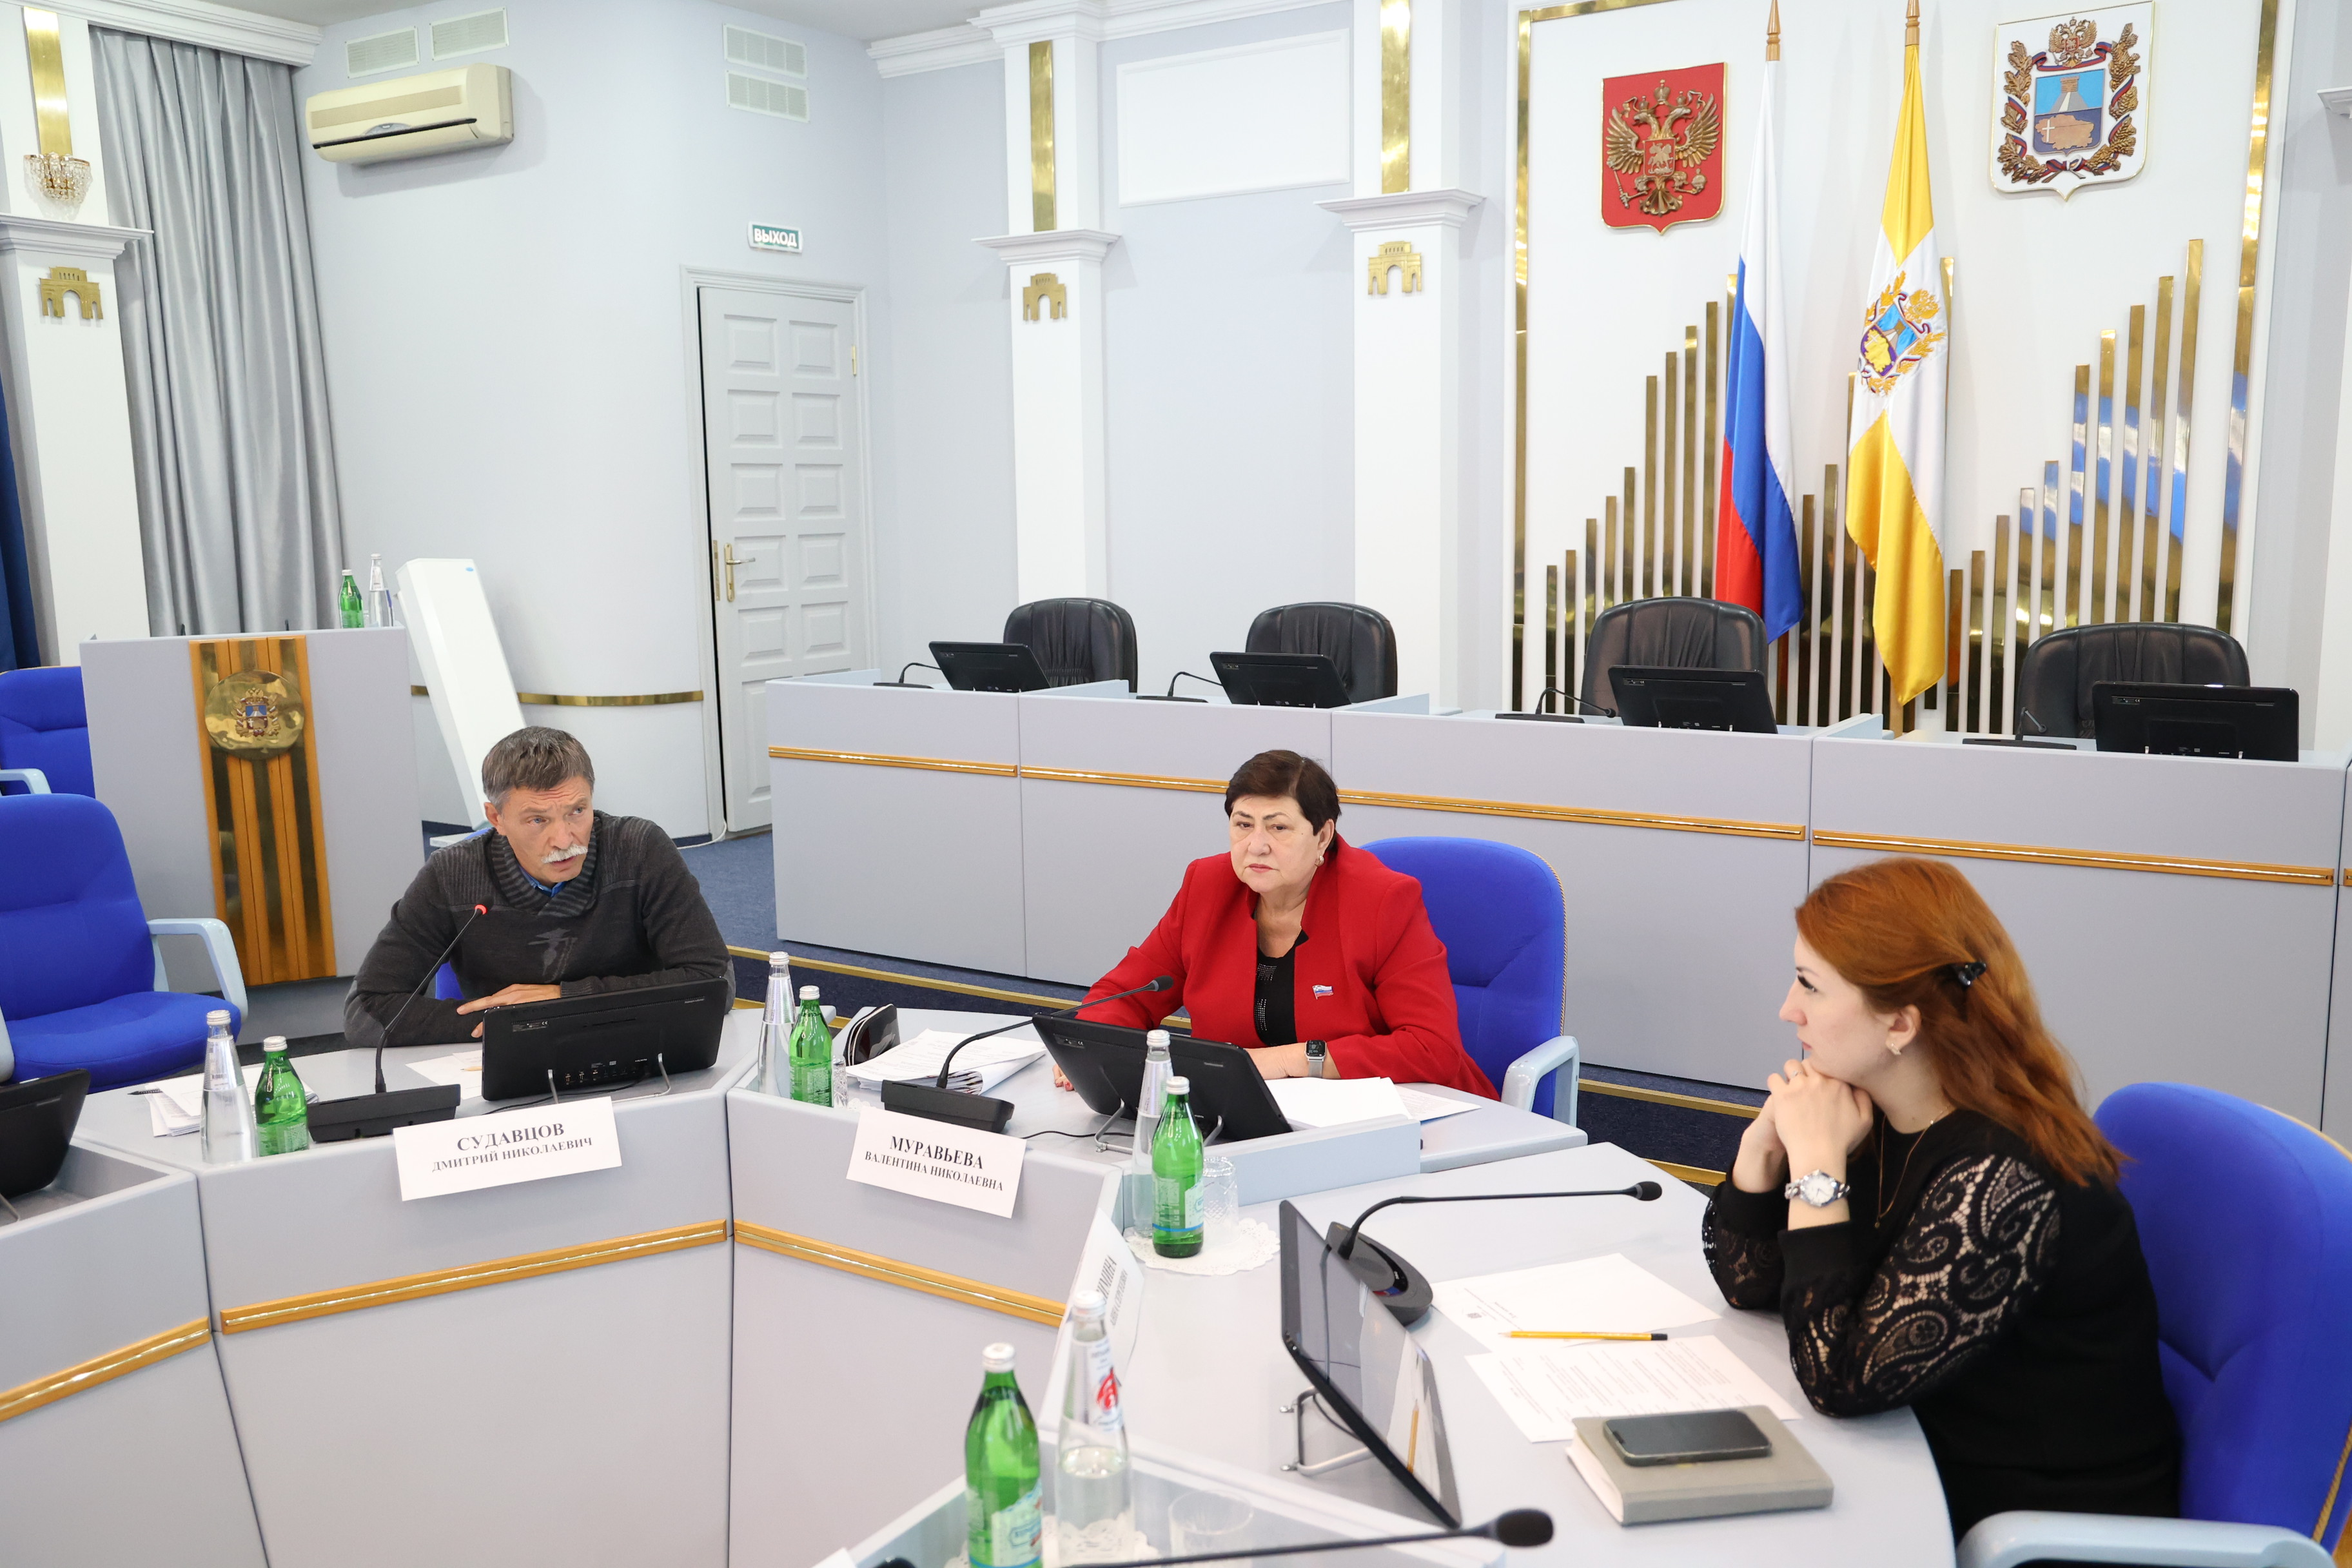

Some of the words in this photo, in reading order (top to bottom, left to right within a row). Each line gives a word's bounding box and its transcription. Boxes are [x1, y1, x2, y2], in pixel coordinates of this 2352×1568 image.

[754, 228, 797, 246] ВЫХОД
[456, 1123, 565, 1151] СУДАВЦОВ
[890, 1136, 983, 1170] МУРАВЬЕВА
[432, 1150, 498, 1172] ДМИТРИЙ
[502, 1137, 593, 1160] НИКОЛАЕВИЧ
[865, 1151, 927, 1174] ВАЛЕНТИНА
[930, 1166, 1003, 1191] НИКОЛАЕВНА
